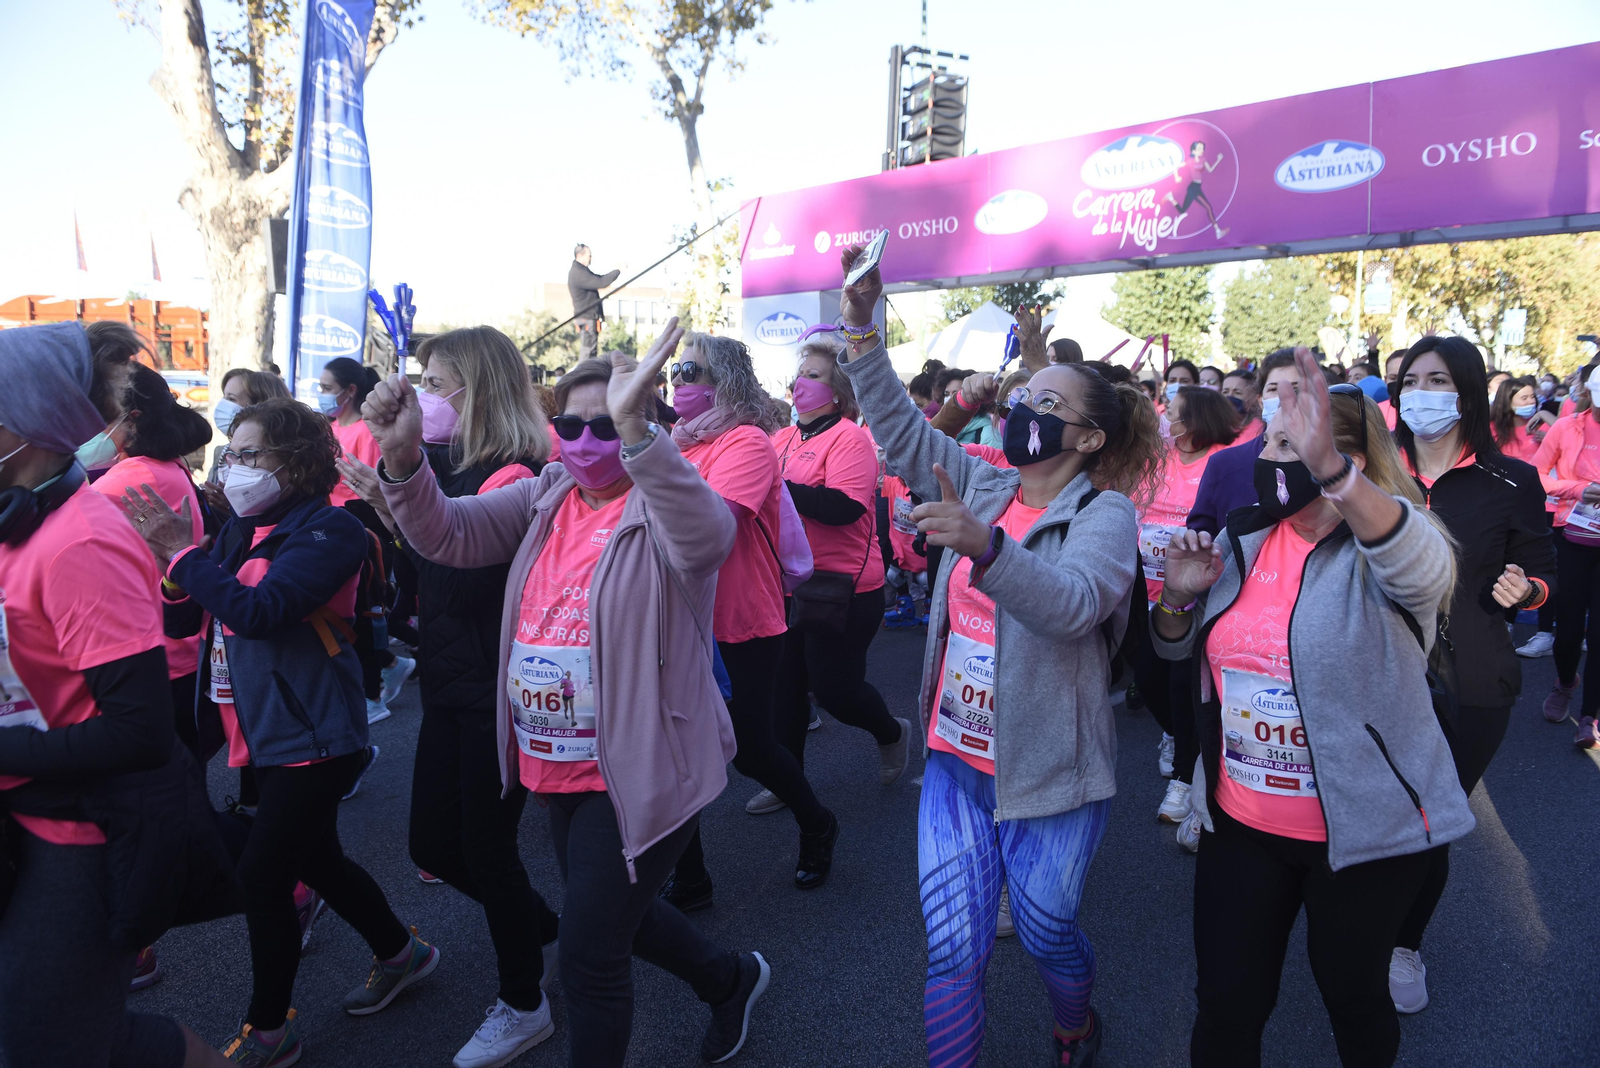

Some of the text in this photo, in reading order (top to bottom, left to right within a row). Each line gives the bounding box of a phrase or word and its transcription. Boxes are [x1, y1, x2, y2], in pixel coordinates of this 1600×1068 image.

[1421, 131, 1538, 168] OYSHO
[1284, 159, 1375, 183] ASTURIANA
[1072, 187, 1156, 218] Carrera
[898, 215, 959, 240] OYSHO
[1092, 203, 1189, 252] de la Mujer
[834, 228, 880, 247] ZURICH
[760, 325, 804, 339] ASTURIANA
[1152, 546, 1166, 557] 01
[541, 606, 590, 622] TODAS
[957, 611, 996, 636] NOS
[212, 647, 224, 665] 01
[1268, 654, 1291, 670] TO
[520, 664, 560, 679] ASTURIANA
[966, 660, 994, 679] ASTURI
[521, 688, 561, 713] 016
[528, 713, 549, 727] 3030
[950, 713, 970, 729] CARRERA
[970, 724, 981, 732] DE
[980, 726, 990, 735] LA
[965, 709, 990, 726] 2722
[543, 728, 552, 736] LA
[551, 729, 577, 737] MUJER
[939, 720, 959, 740] OYSHO
[1254, 721, 1309, 748] 016
[1241, 755, 1313, 773] CARRERA DE LA MU
[1266, 748, 1295, 762] 3141
[1228, 765, 1261, 783] OYSHO
[1274, 779, 1296, 787] Santander
